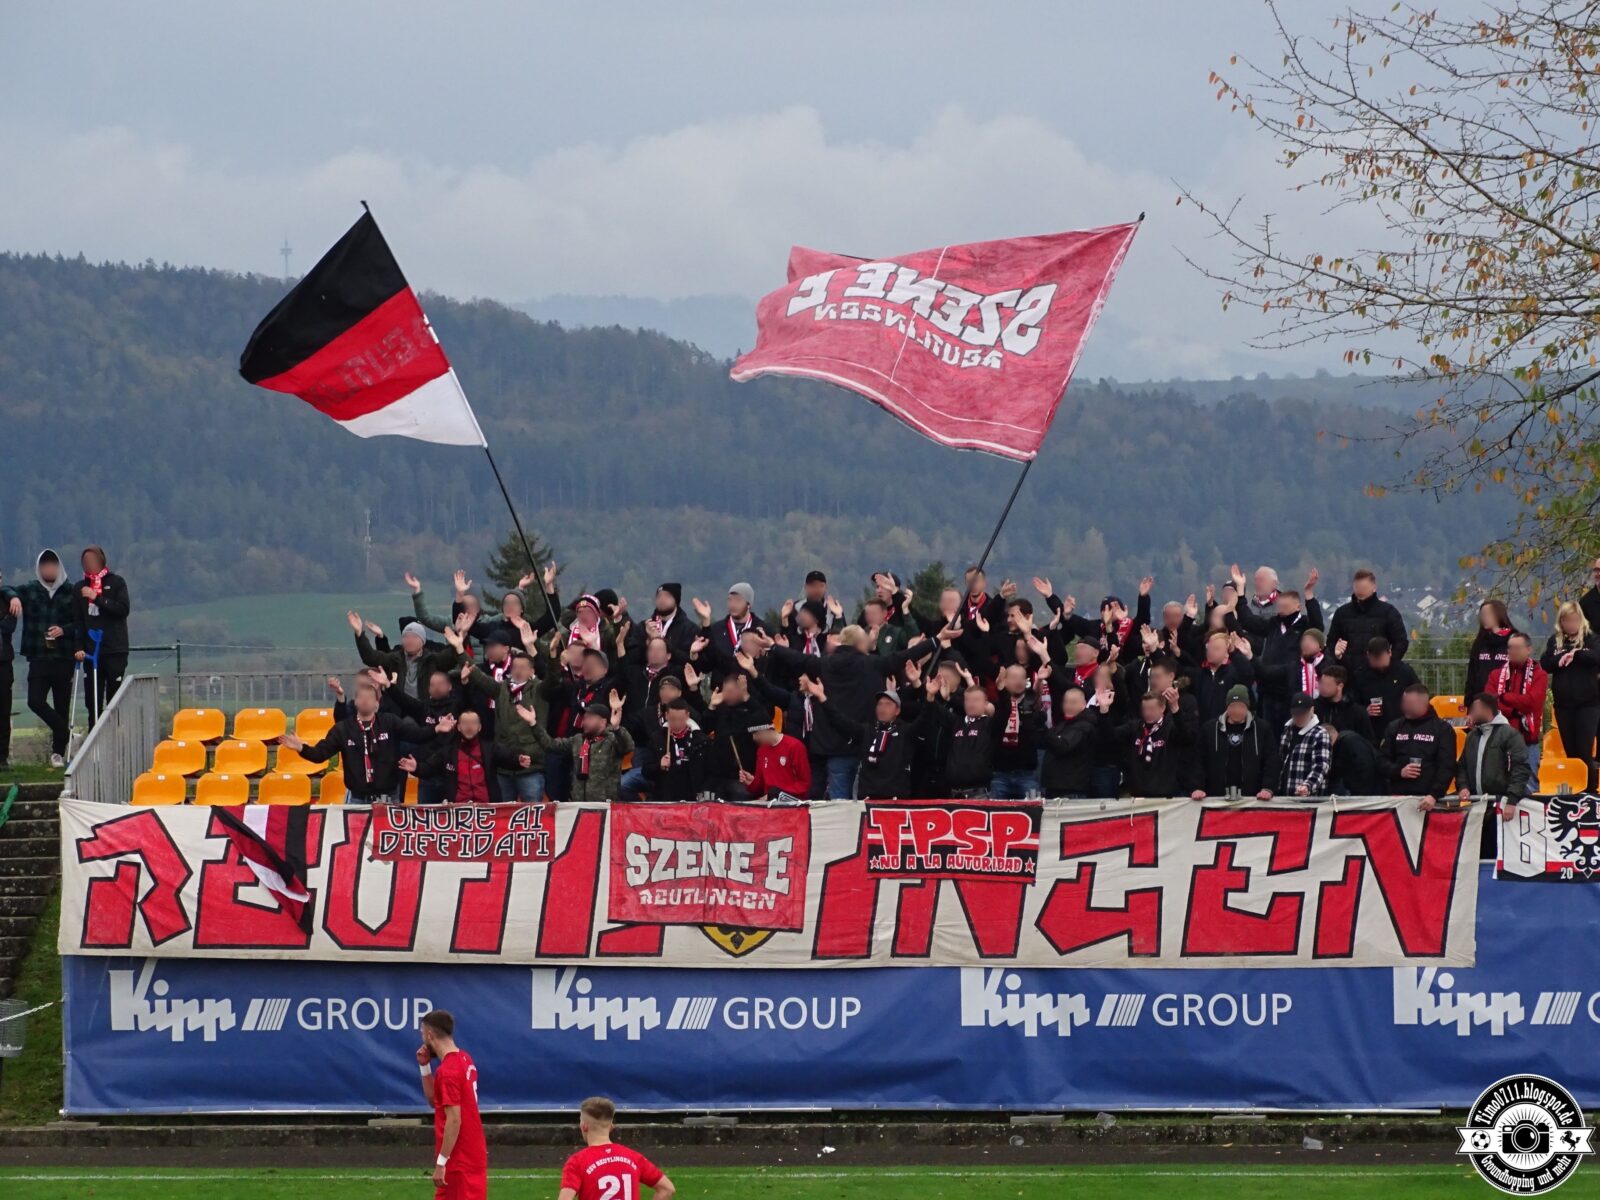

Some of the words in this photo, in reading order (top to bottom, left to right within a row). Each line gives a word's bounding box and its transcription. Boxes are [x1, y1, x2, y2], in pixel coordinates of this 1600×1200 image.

[388, 805, 496, 831] ONORE
[509, 804, 545, 831] AI
[870, 808, 1032, 857] TPSP
[379, 831, 550, 858] DIFFIDATI
[625, 832, 755, 887] SZENE
[764, 836, 793, 895] E
[879, 855, 900, 869] NO
[906, 854, 917, 869] A
[922, 854, 942, 869] LA
[946, 855, 1023, 873] AUTORIDAD
[1560, 867, 1574, 879] 20
[639, 887, 777, 910] REUTLINGEN
[109, 958, 236, 1042] Kipp
[530, 966, 660, 1041] Kipp
[723, 997, 861, 1030] GROUP
[960, 967, 1090, 1037] Kipp
[1152, 993, 1292, 1026] GROUP
[1393, 966, 1524, 1036] Kipp
[598, 1173, 632, 1200] 21
